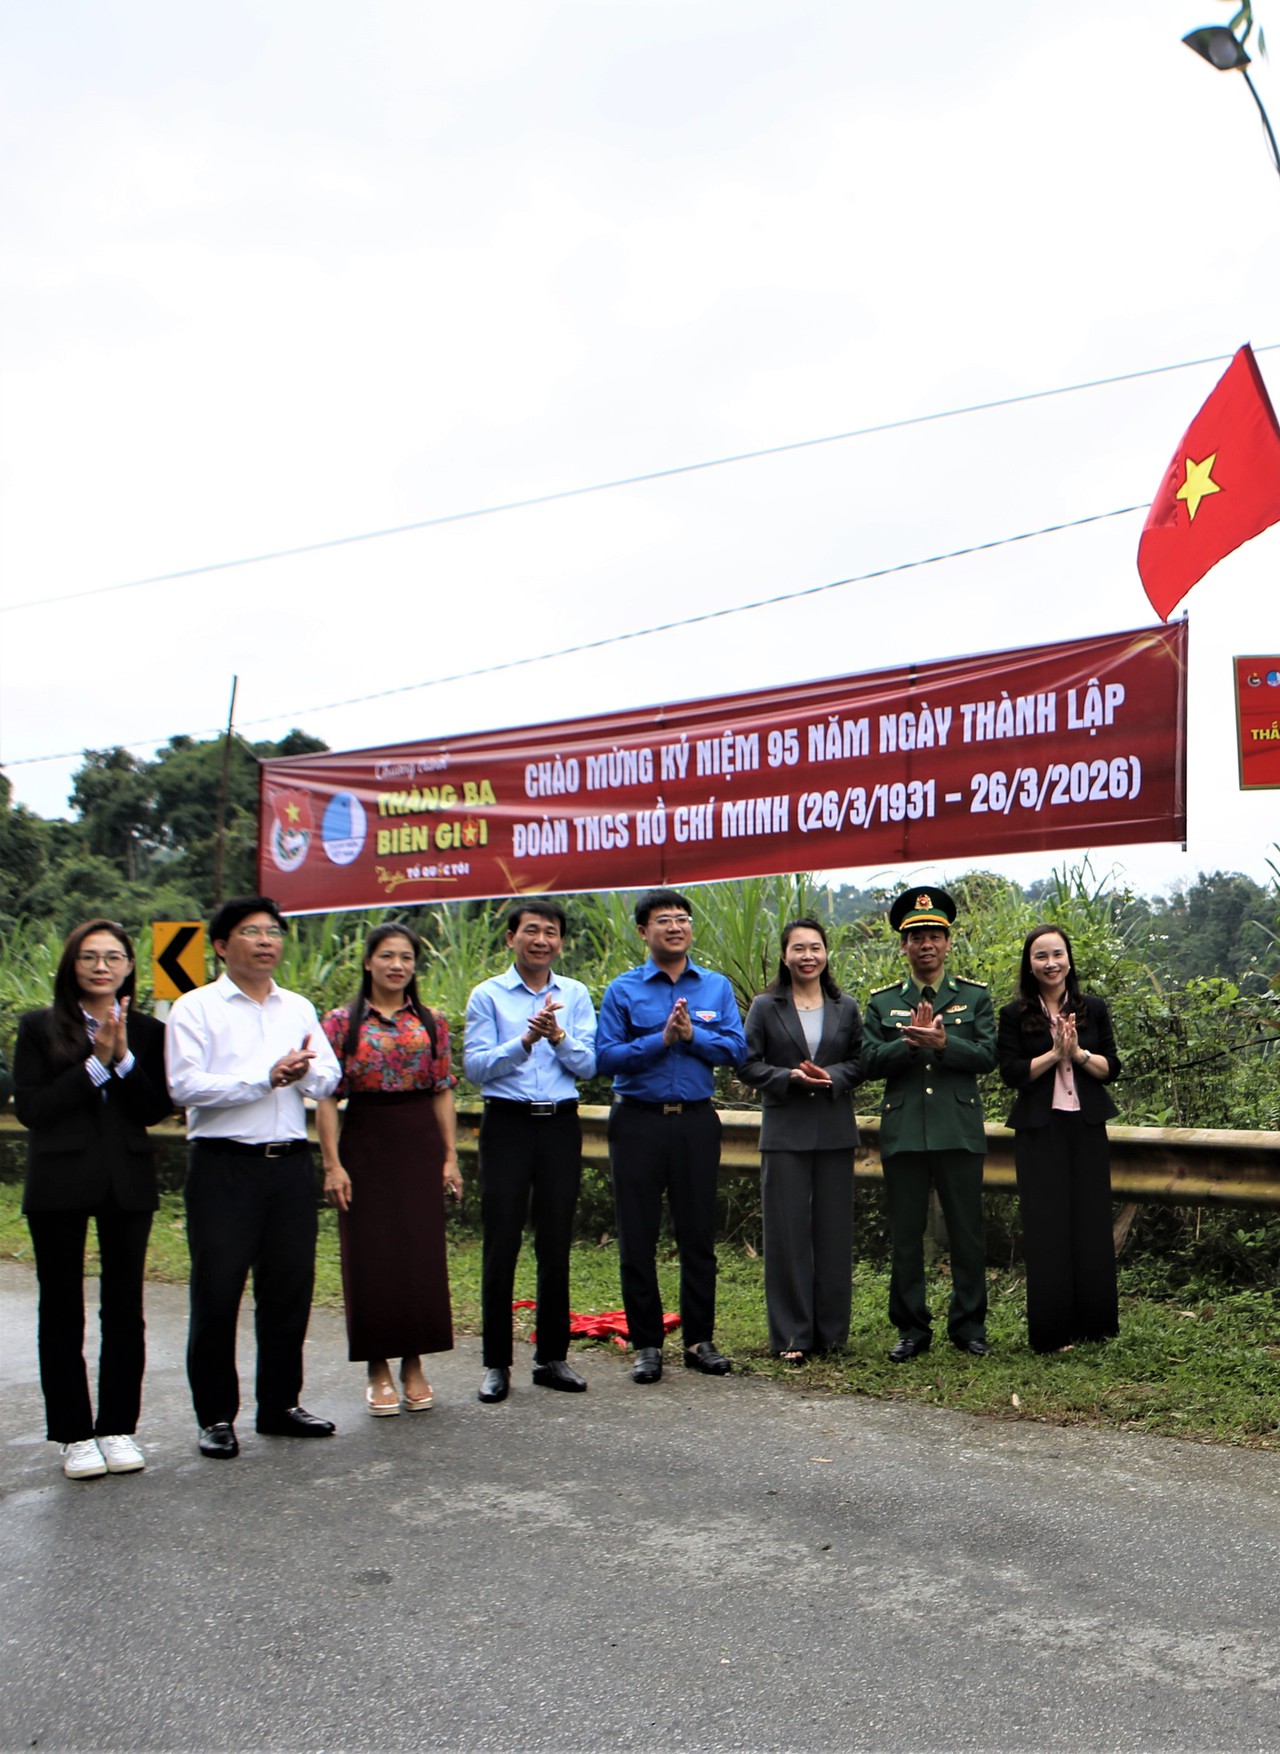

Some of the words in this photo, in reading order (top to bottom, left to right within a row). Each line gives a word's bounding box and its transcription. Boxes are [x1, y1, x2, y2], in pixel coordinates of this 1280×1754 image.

[525, 754, 580, 798] CHÀO
[586, 745, 653, 790] MỪNG
[661, 733, 690, 781] KỶ
[696, 730, 759, 781] NIỆM
[767, 728, 799, 768] 95
[808, 715, 869, 762] NĂM
[879, 701, 951, 753] NGÀY
[960, 690, 1056, 742] THÀNH
[1067, 677, 1125, 736] LẬP
[463, 779, 497, 807] BA
[512, 814, 568, 858] ĐOÀN
[573, 812, 629, 851] TNCS
[636, 796, 667, 846] HỒ
[673, 796, 715, 842] CHÍ
[721, 795, 788, 838] MINH
[798, 779, 935, 833] (26/3/1931
[970, 755, 1141, 815] 26/3/2026)
[376, 822, 428, 855] BIÊN
